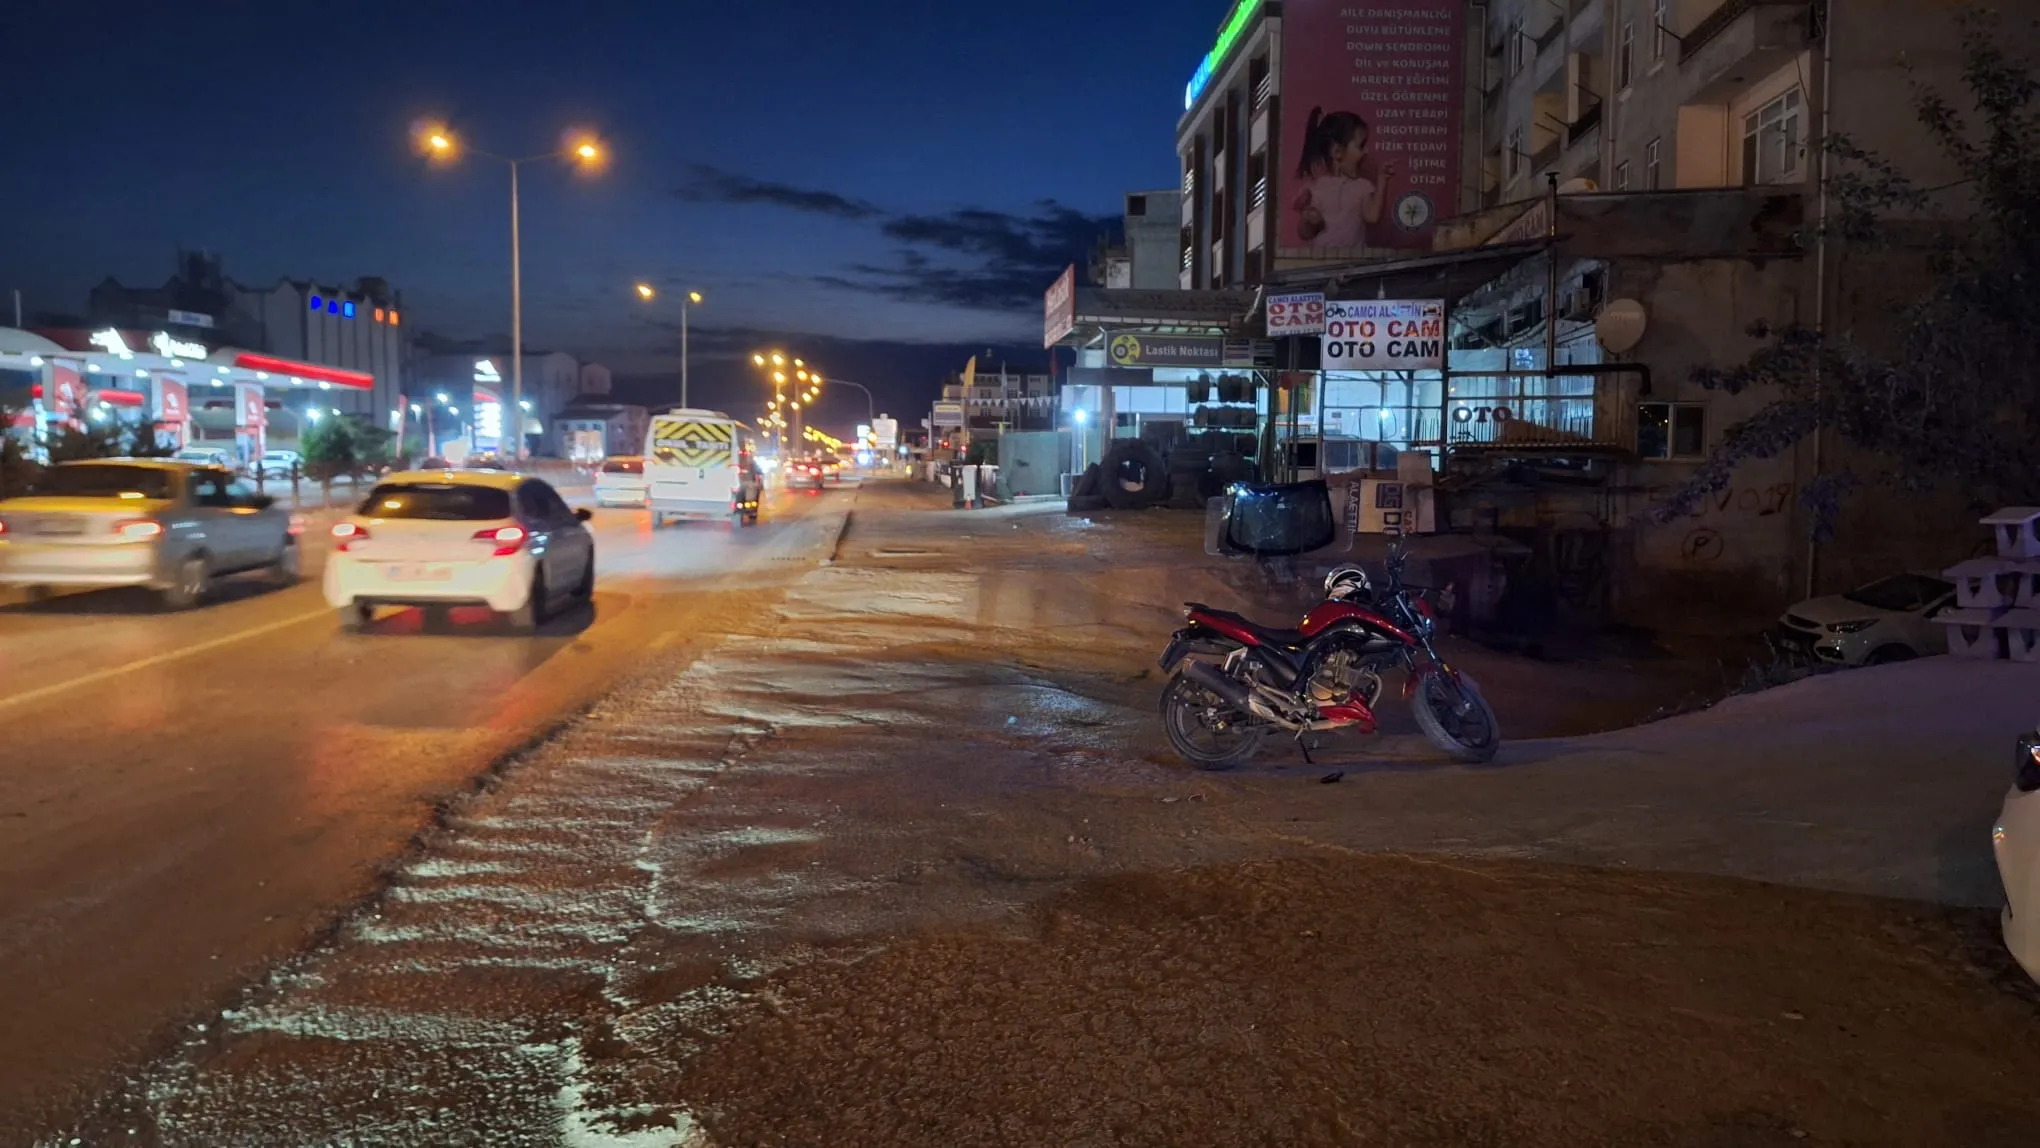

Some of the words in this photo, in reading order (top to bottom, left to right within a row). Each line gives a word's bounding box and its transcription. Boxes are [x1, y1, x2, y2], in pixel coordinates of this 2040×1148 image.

[1346, 41, 1383, 51] DOWN
[1384, 42, 1450, 52] SENDROMU
[1352, 75, 1403, 85] HAREKET
[1375, 108, 1406, 118] UZAY
[1269, 302, 1323, 314] OTO
[1348, 306, 1376, 318] CAMCI
[1270, 312, 1323, 327] CAM
[1328, 320, 1376, 339] OTO
[1387, 320, 1440, 339] CAM
[1145, 345, 1177, 357] Lastik
[1179, 345, 1219, 358] Noktası
[1327, 341, 1375, 358] OTO
[1386, 341, 1439, 358] CAM
[1452, 406, 1513, 423] OTO
